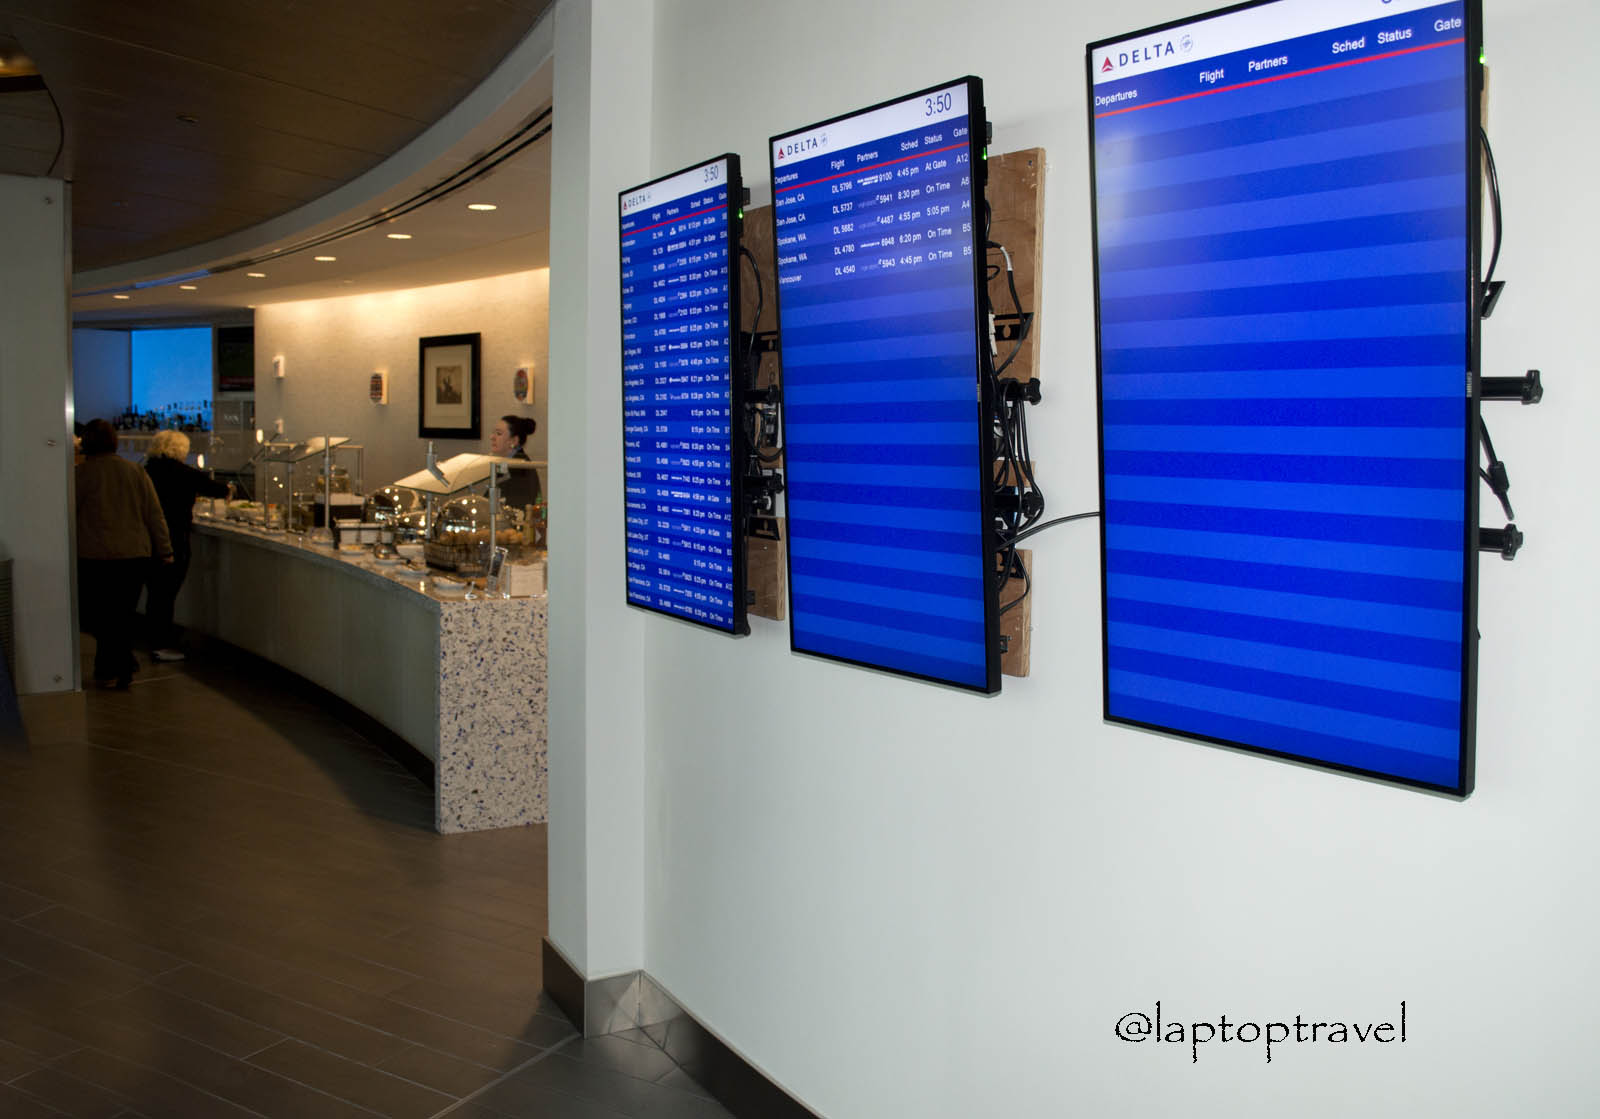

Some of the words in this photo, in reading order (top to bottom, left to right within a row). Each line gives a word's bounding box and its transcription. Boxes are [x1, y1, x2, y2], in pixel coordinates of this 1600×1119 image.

[1095, 88, 1138, 106] Departures
[1199, 67, 1224, 84] Flight
[1248, 54, 1289, 72] Partners
[1331, 36, 1365, 54] Sched
[1377, 27, 1412, 45] Status
[1433, 16, 1462, 33] Gate
[1118, 41, 1175, 68] DELTA
[925, 92, 952, 117] 3:50
[787, 137, 818, 156] DELTA
[831, 159, 845, 171] Flight
[857, 151, 879, 163] Partners
[900, 139, 919, 151] Sched
[924, 134, 943, 145] Status
[953, 127, 968, 138] Gate
[832, 185, 839, 194] DL
[897, 166, 909, 177] 4:45
[910, 166, 919, 176] pm
[925, 161, 932, 171] At
[932, 159, 947, 170] Gate
[956, 153, 969, 165] A12
[832, 206, 840, 214] DL
[911, 188, 920, 198] pm
[926, 183, 935, 193] On
[935, 181, 951, 192] Time
[833, 226, 841, 235] DL
[912, 211, 921, 220] pm
[940, 204, 950, 215] pm
[834, 247, 841, 255] DL
[912, 233, 922, 243] pm
[927, 229, 936, 239] On
[936, 227, 952, 238] Time
[835, 267, 842, 276] DL
[913, 254, 923, 264] pm
[928, 251, 937, 261] On
[937, 249, 953, 260] Time
